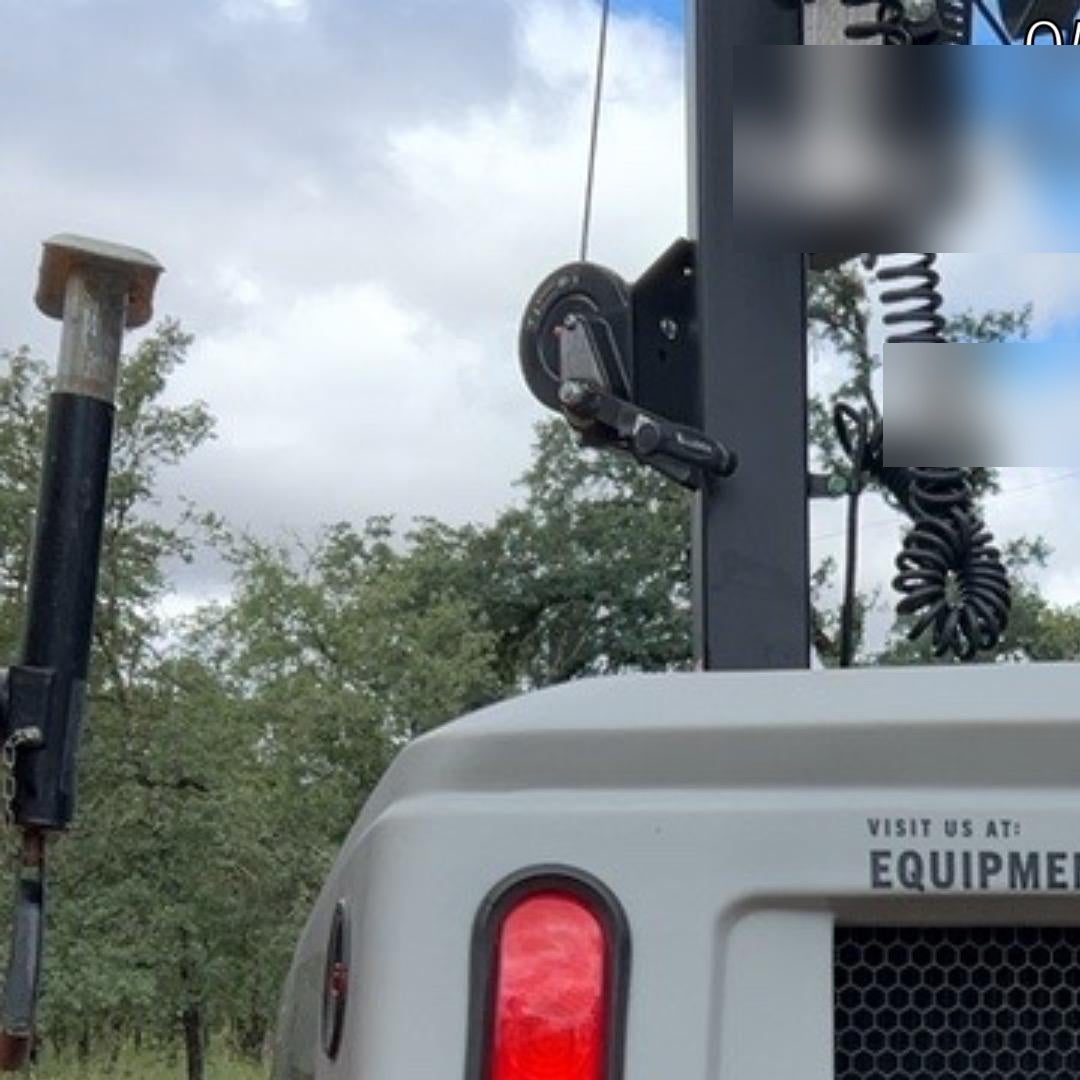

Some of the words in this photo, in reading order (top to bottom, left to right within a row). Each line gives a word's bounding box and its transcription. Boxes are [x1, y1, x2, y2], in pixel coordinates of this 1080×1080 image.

[867, 818, 932, 837] VISIT
[944, 818, 973, 837] US
[985, 819, 1021, 838] AT:
